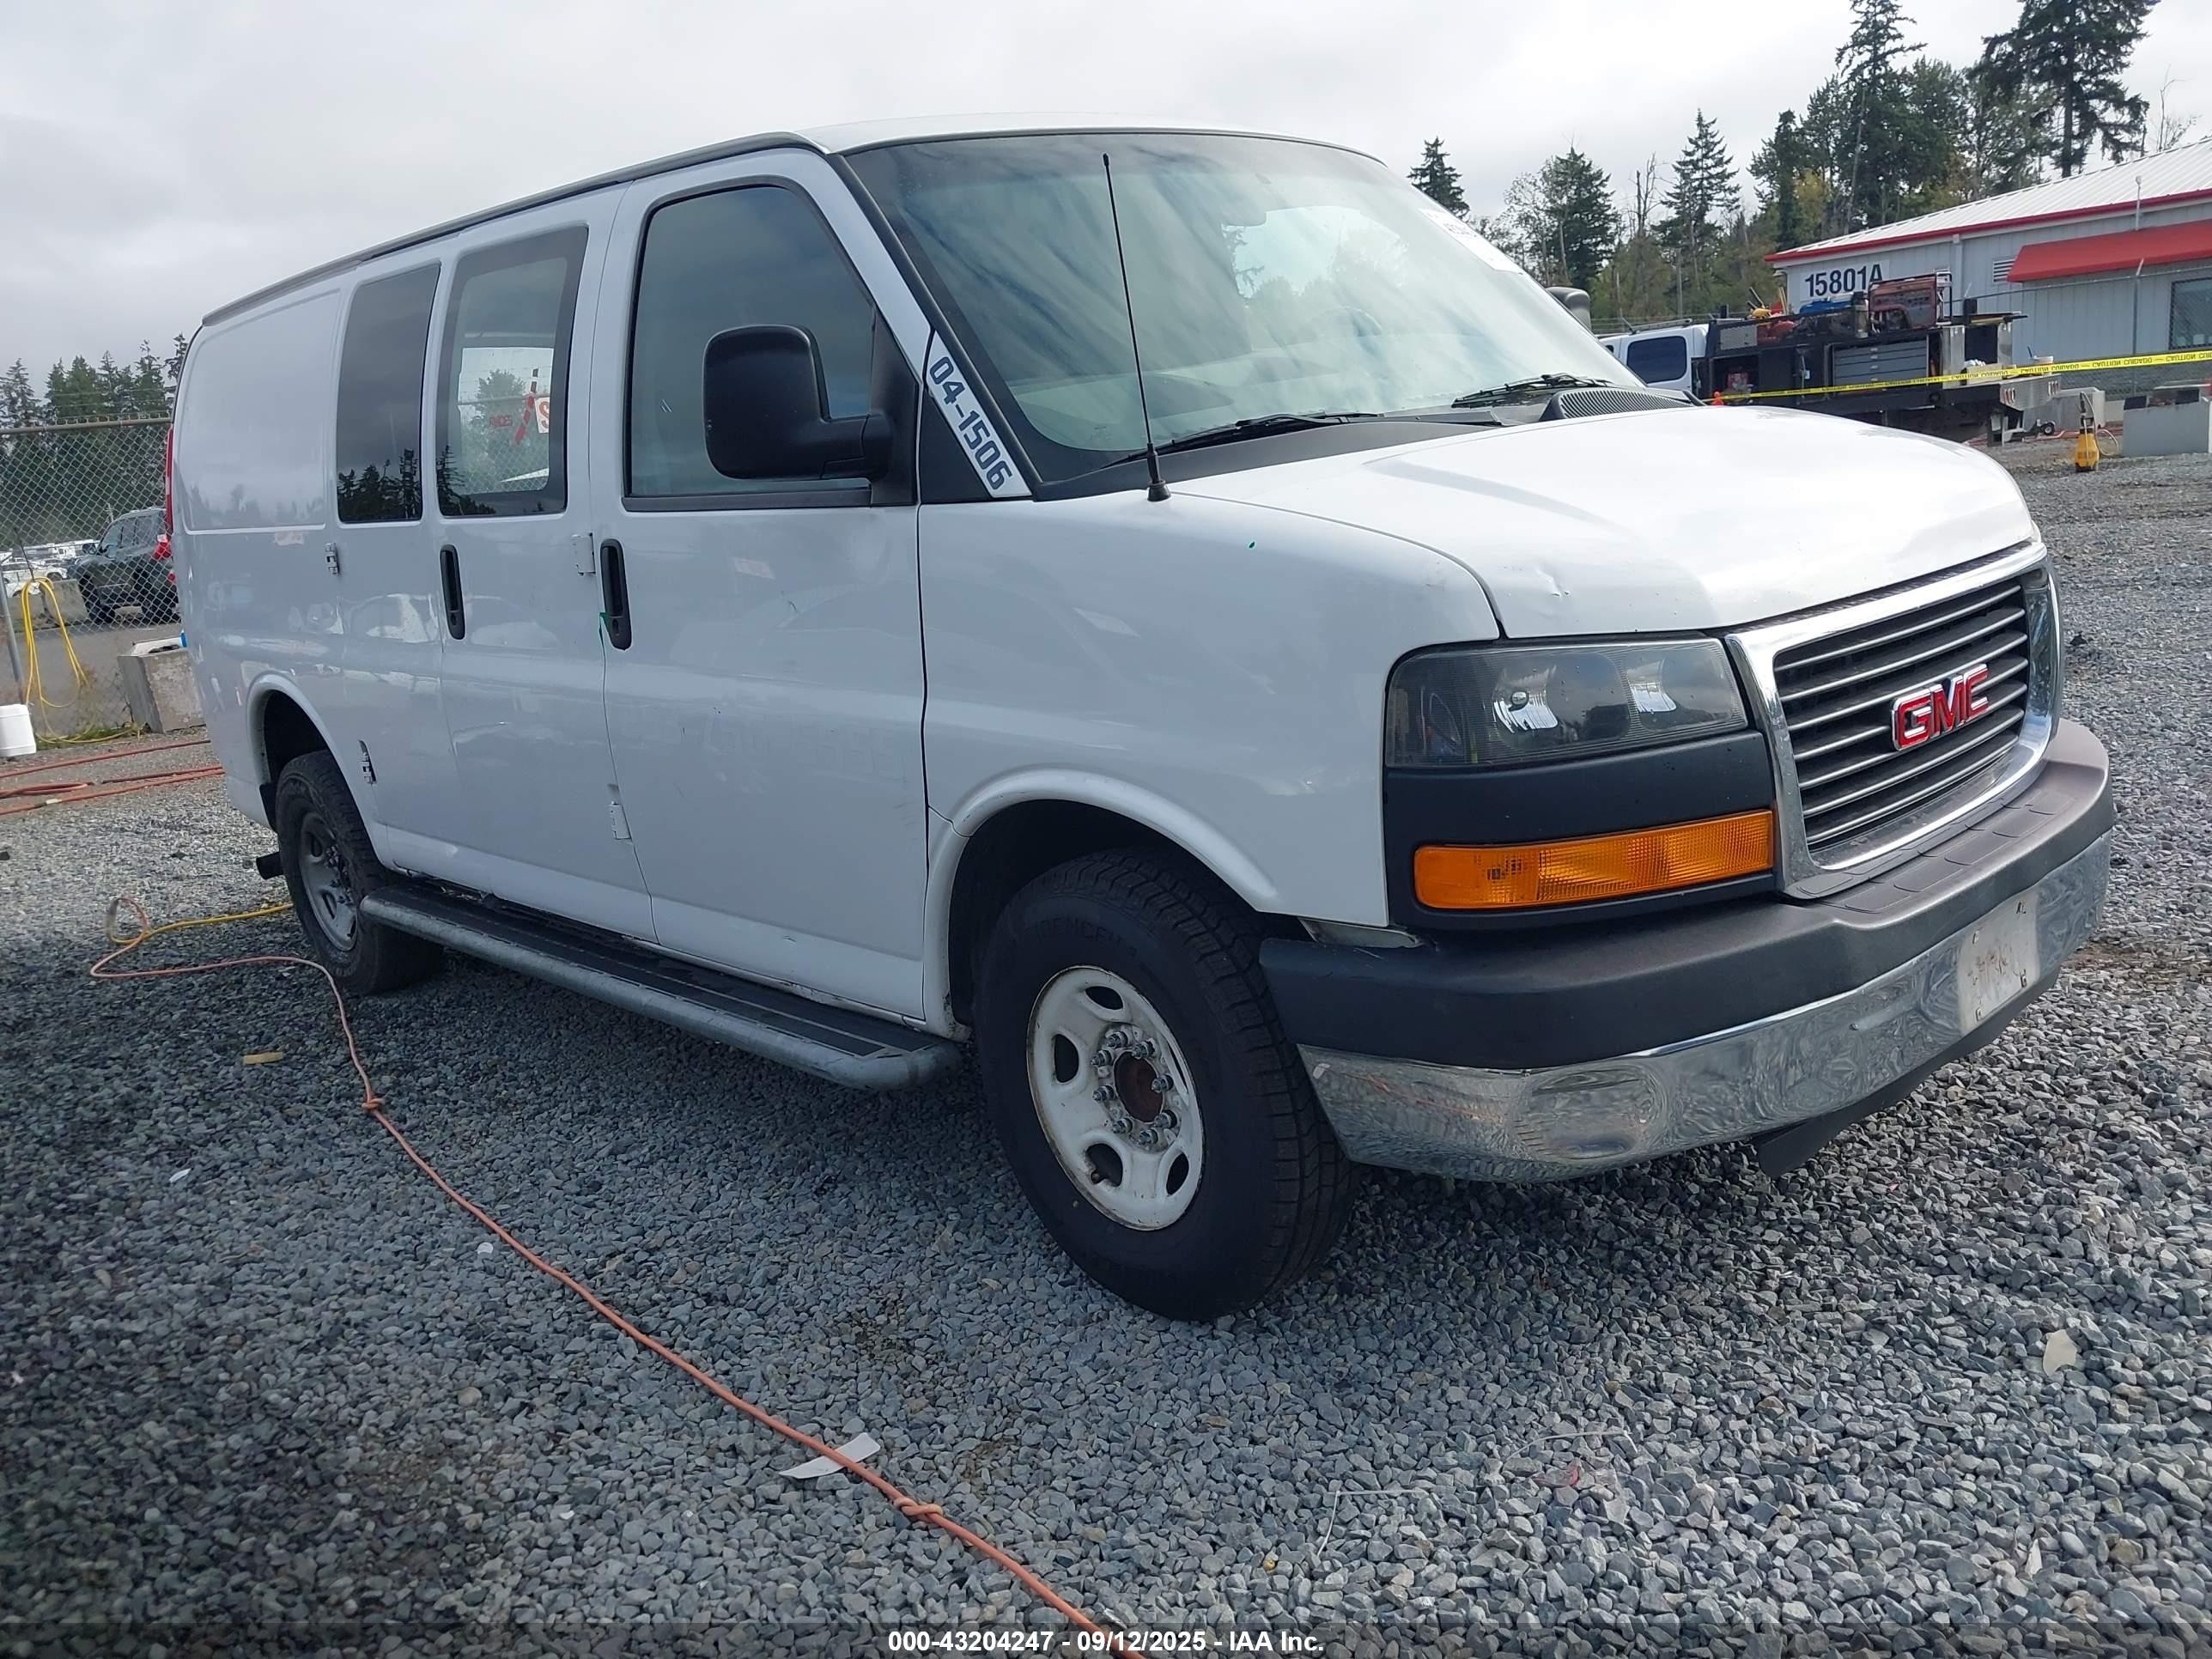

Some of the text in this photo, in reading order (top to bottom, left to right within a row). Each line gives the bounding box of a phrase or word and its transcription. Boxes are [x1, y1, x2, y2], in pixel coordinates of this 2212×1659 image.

[1805, 264, 1883, 297] 15801A
[929, 356, 1012, 490] 04-1506
[1892, 663, 1989, 751] GMC
